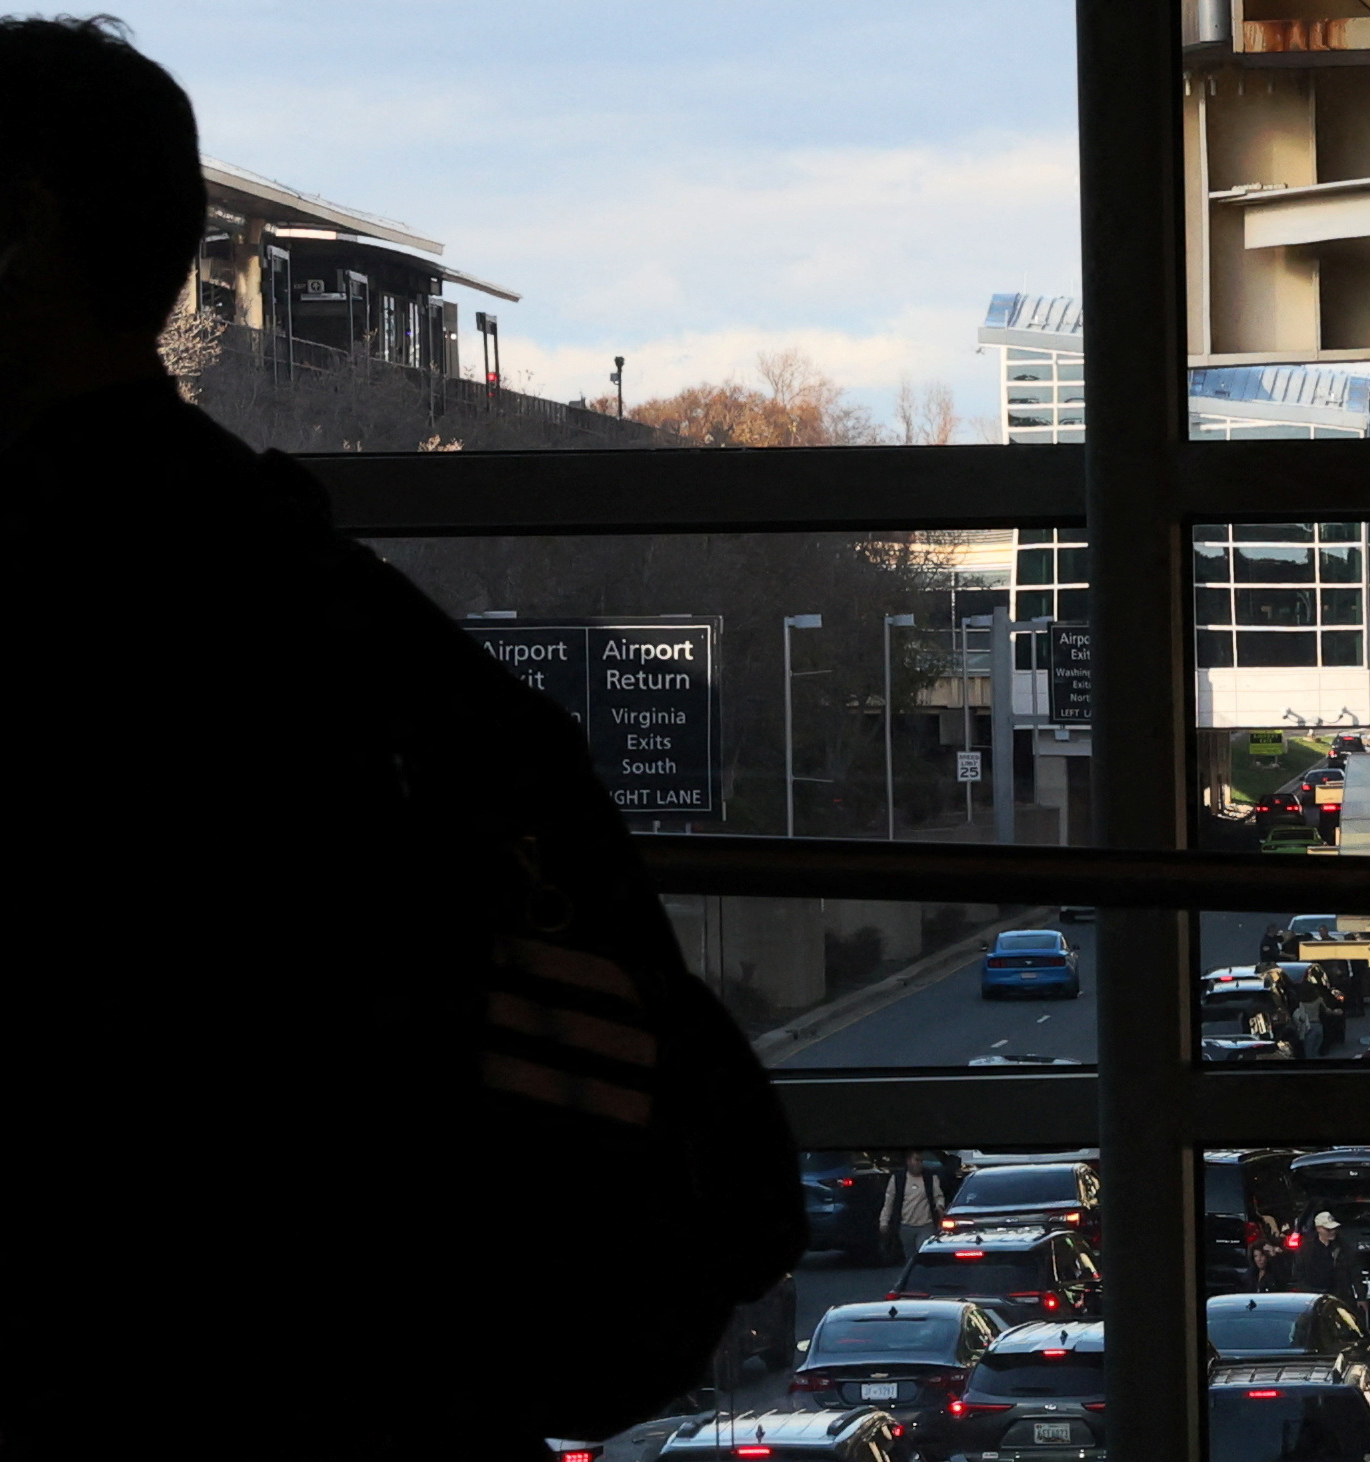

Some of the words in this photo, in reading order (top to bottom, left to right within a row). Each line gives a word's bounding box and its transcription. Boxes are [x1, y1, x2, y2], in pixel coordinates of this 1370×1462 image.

[602, 639, 694, 665] Airport
[606, 669, 691, 690] Return
[611, 707, 687, 728] Virginia
[1061, 708, 1079, 717] LEFT
[626, 733, 672, 750] Exits
[622, 758, 677, 774] South
[960, 767, 979, 778] 25
[609, 789, 651, 805] GHT
[656, 789, 701, 805] LANE
